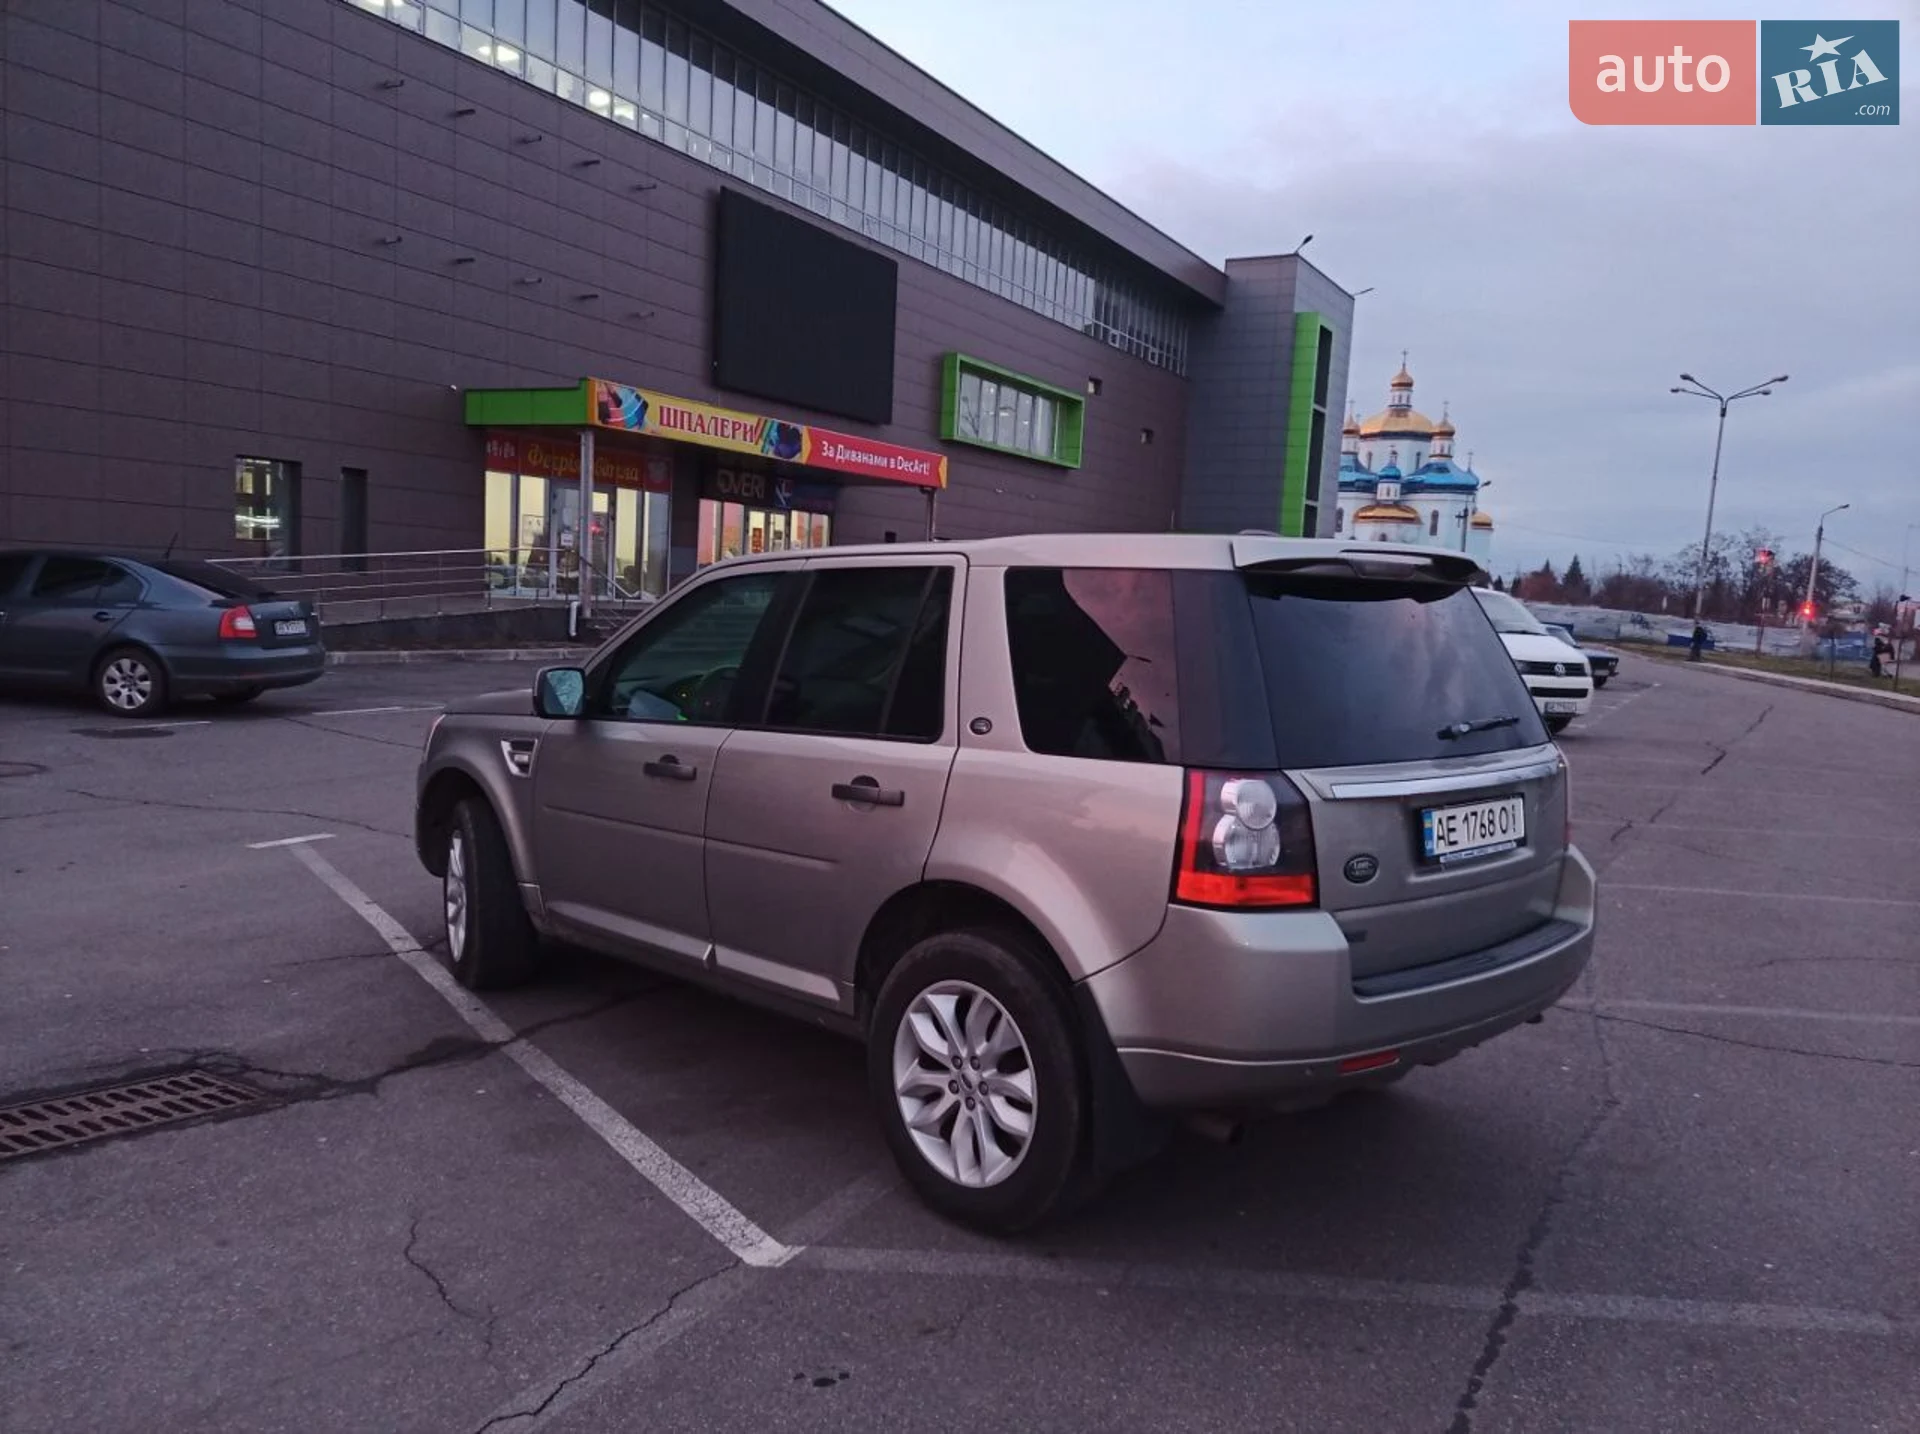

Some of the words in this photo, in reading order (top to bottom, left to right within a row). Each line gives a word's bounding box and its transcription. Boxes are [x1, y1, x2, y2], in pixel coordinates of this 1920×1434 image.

[659, 405, 756, 443] ШПАЛЕРИ
[821, 441, 835, 458] За
[836, 444, 888, 469] Диванами
[1436, 815, 1459, 849] AE
[1462, 808, 1497, 843] 1768
